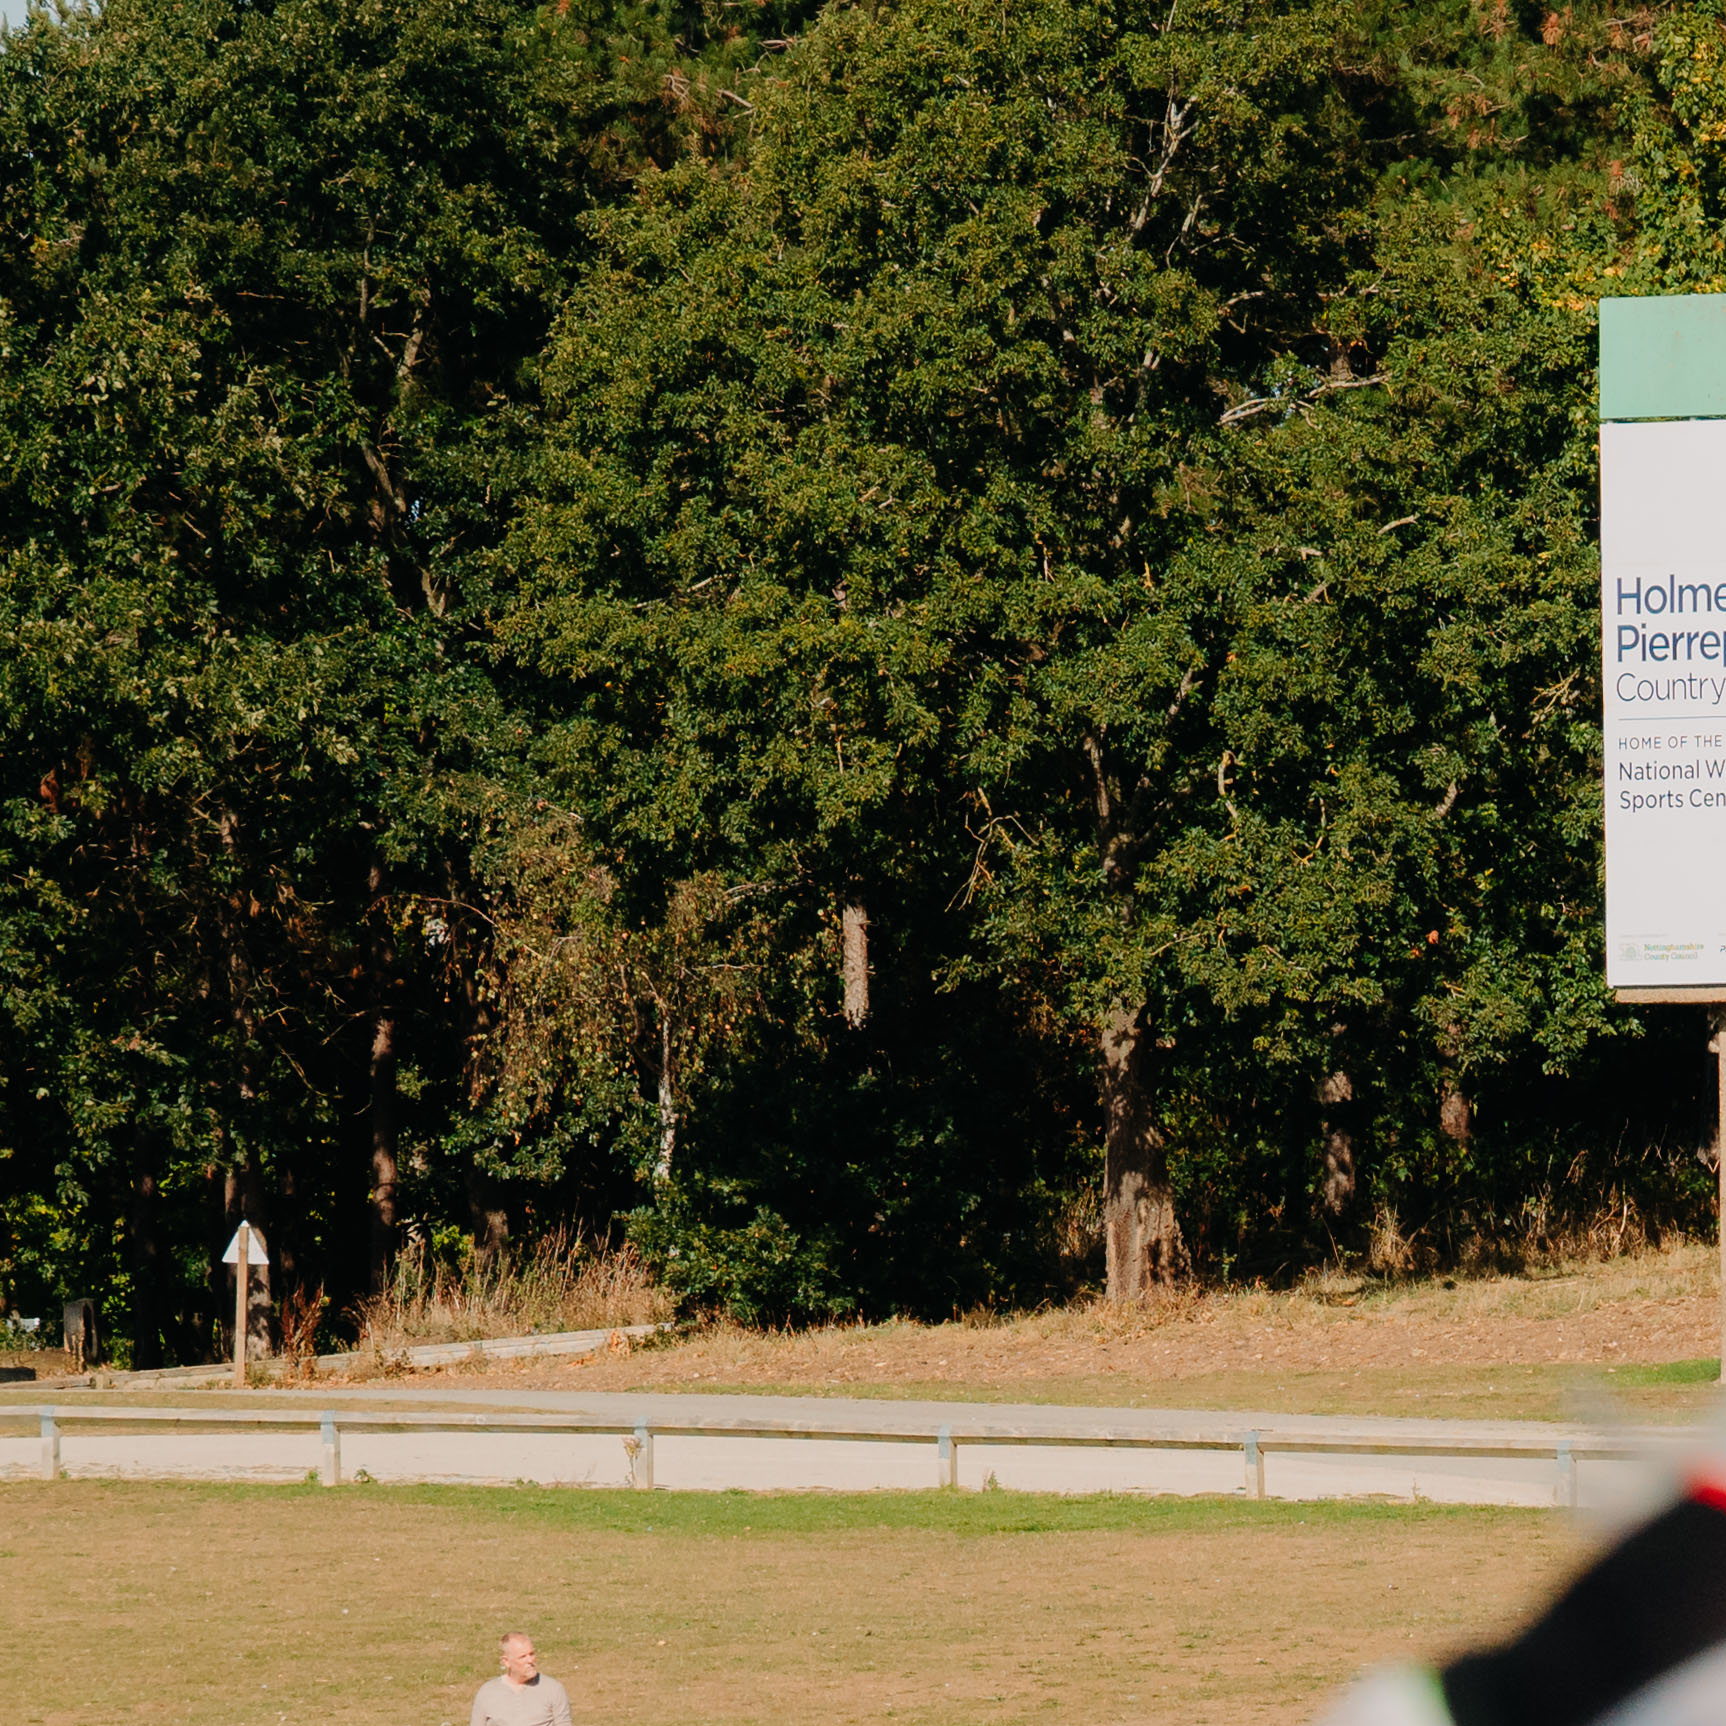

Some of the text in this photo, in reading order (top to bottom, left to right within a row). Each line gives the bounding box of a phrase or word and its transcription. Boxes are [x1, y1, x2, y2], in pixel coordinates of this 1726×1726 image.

[1617, 672, 1726, 705] Country
[1618, 735, 1722, 750] HOME OF THE
[1619, 760, 1699, 781] National
[1620, 790, 1684, 813] Sports
